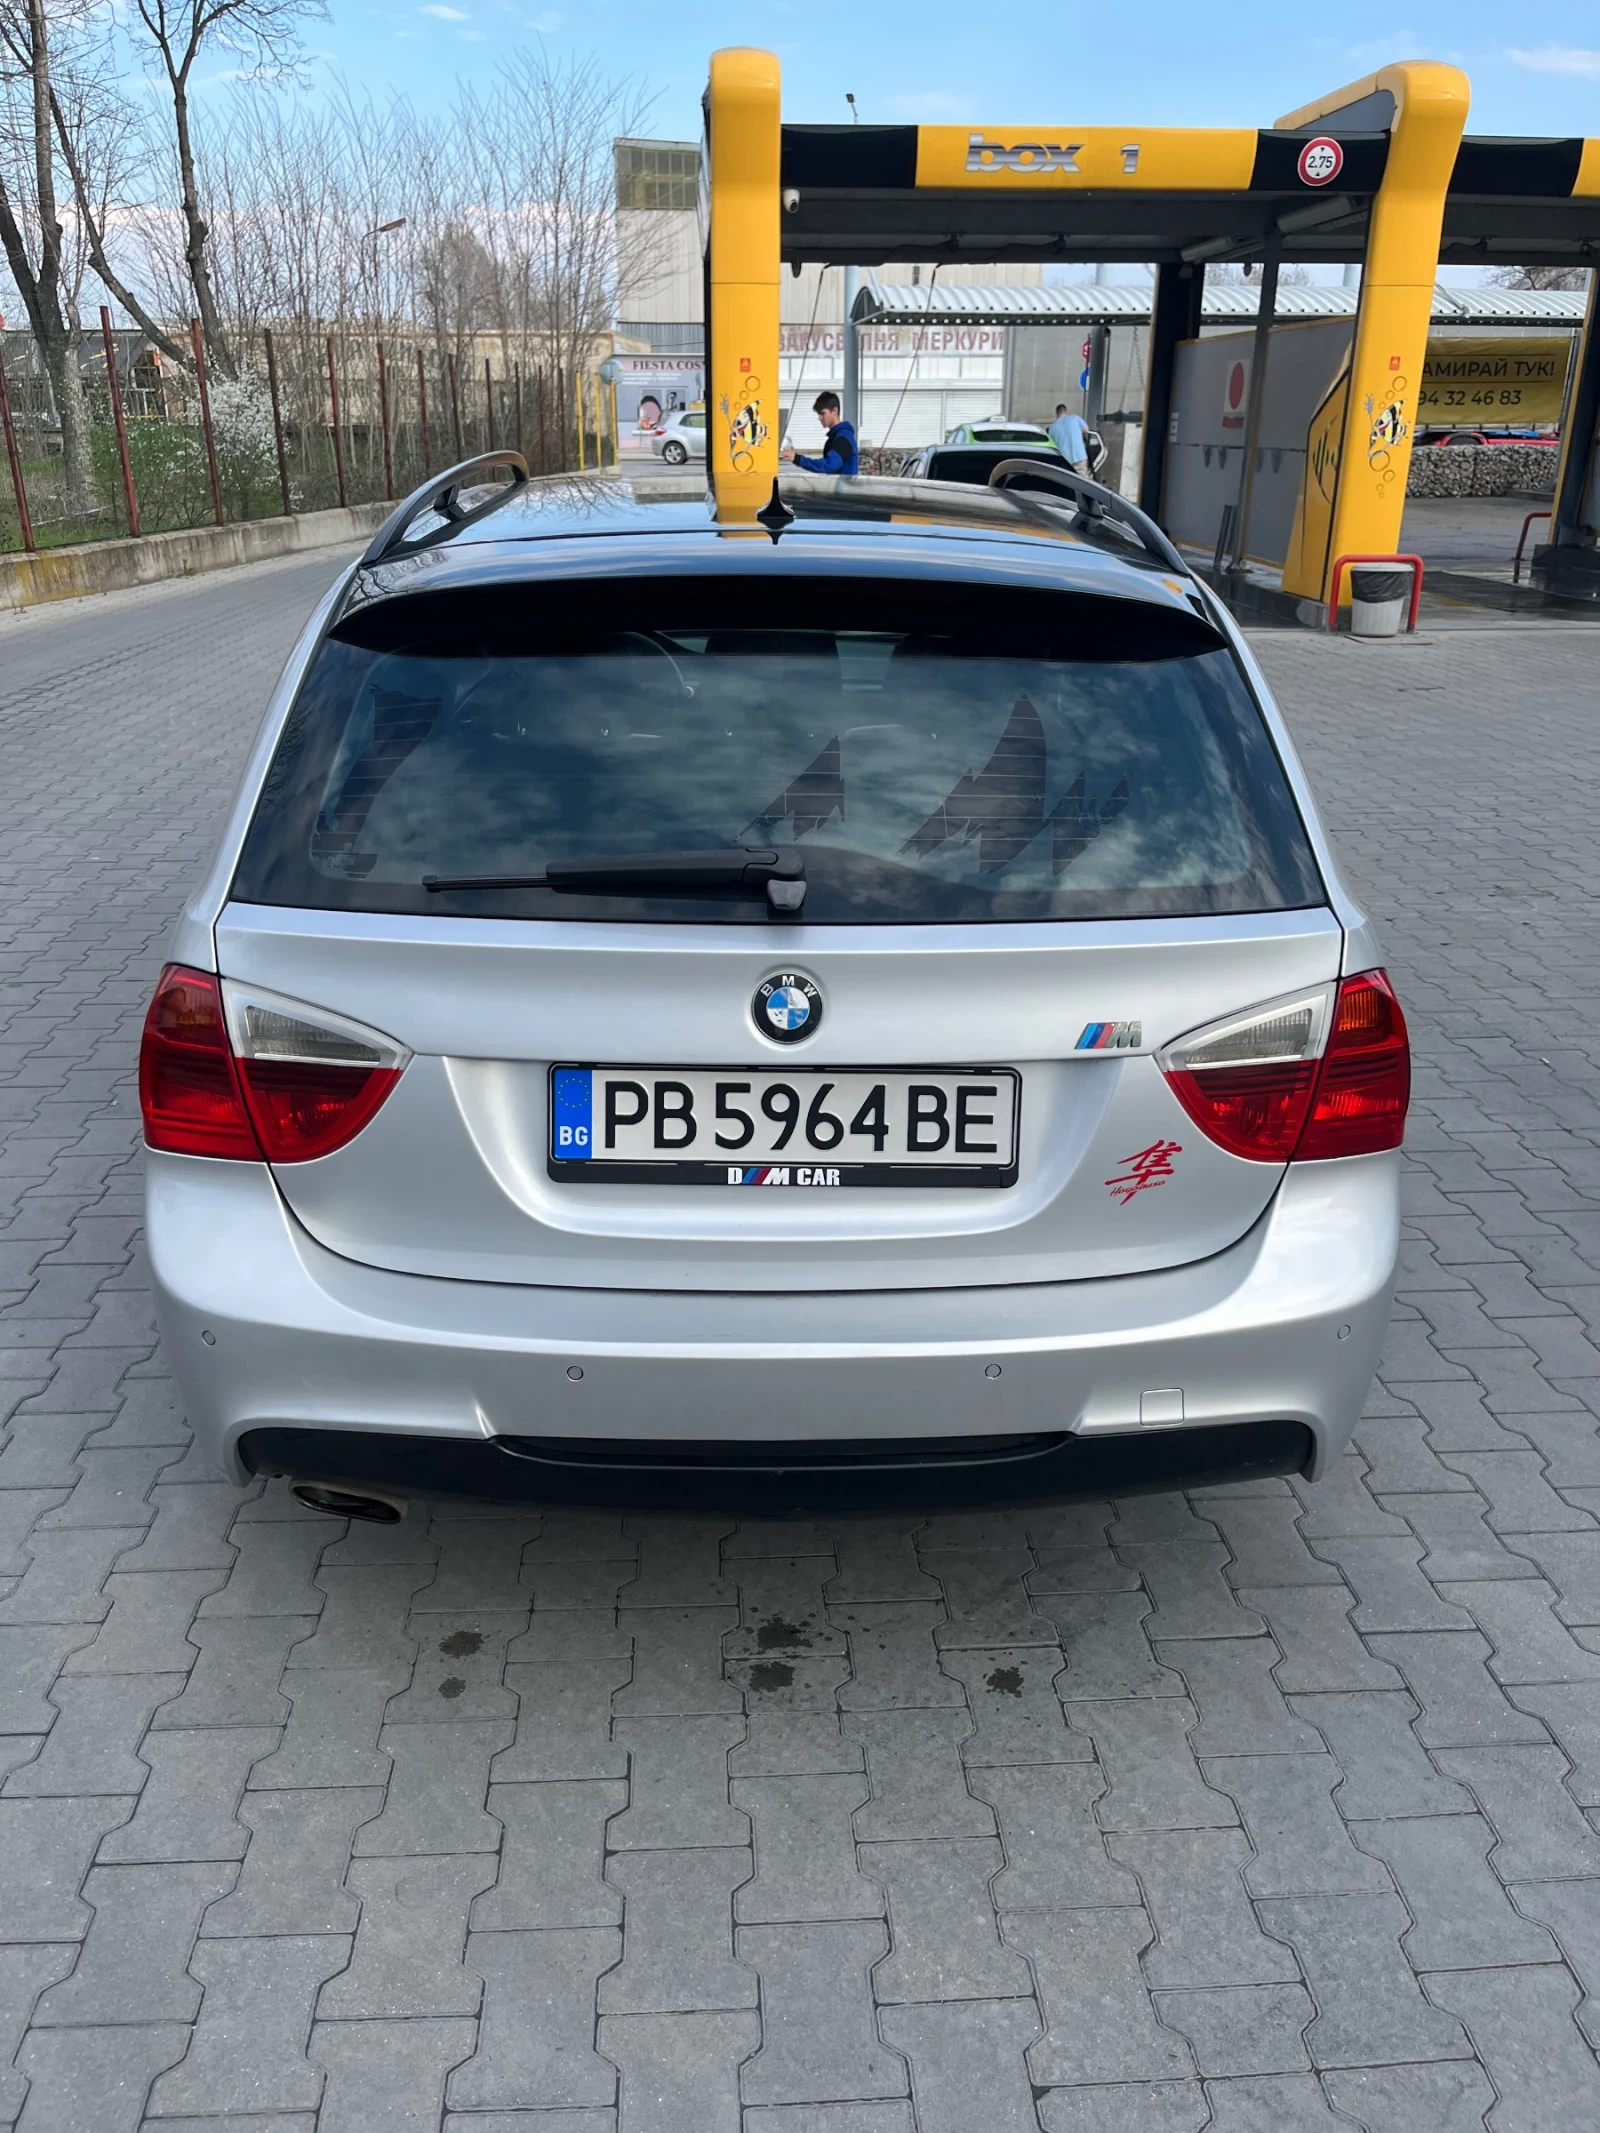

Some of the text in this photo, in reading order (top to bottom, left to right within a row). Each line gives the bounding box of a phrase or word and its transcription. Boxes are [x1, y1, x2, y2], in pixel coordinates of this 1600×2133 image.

[965, 133, 1141, 174] box 1
[1307, 155, 1334, 168] 2.75
[778, 333, 900, 351] ЗАКУСВЛНЯ
[633, 360, 705, 370] FIESTA COS
[1514, 361, 1555, 376] ТУК!
[1444, 390, 1466, 406] 32
[1471, 390, 1494, 405] 46
[1500, 390, 1522, 405] 83
[760, 975, 817, 998] BMW
[559, 1126, 588, 1146] BG
[797, 1168, 840, 1186] CAR
